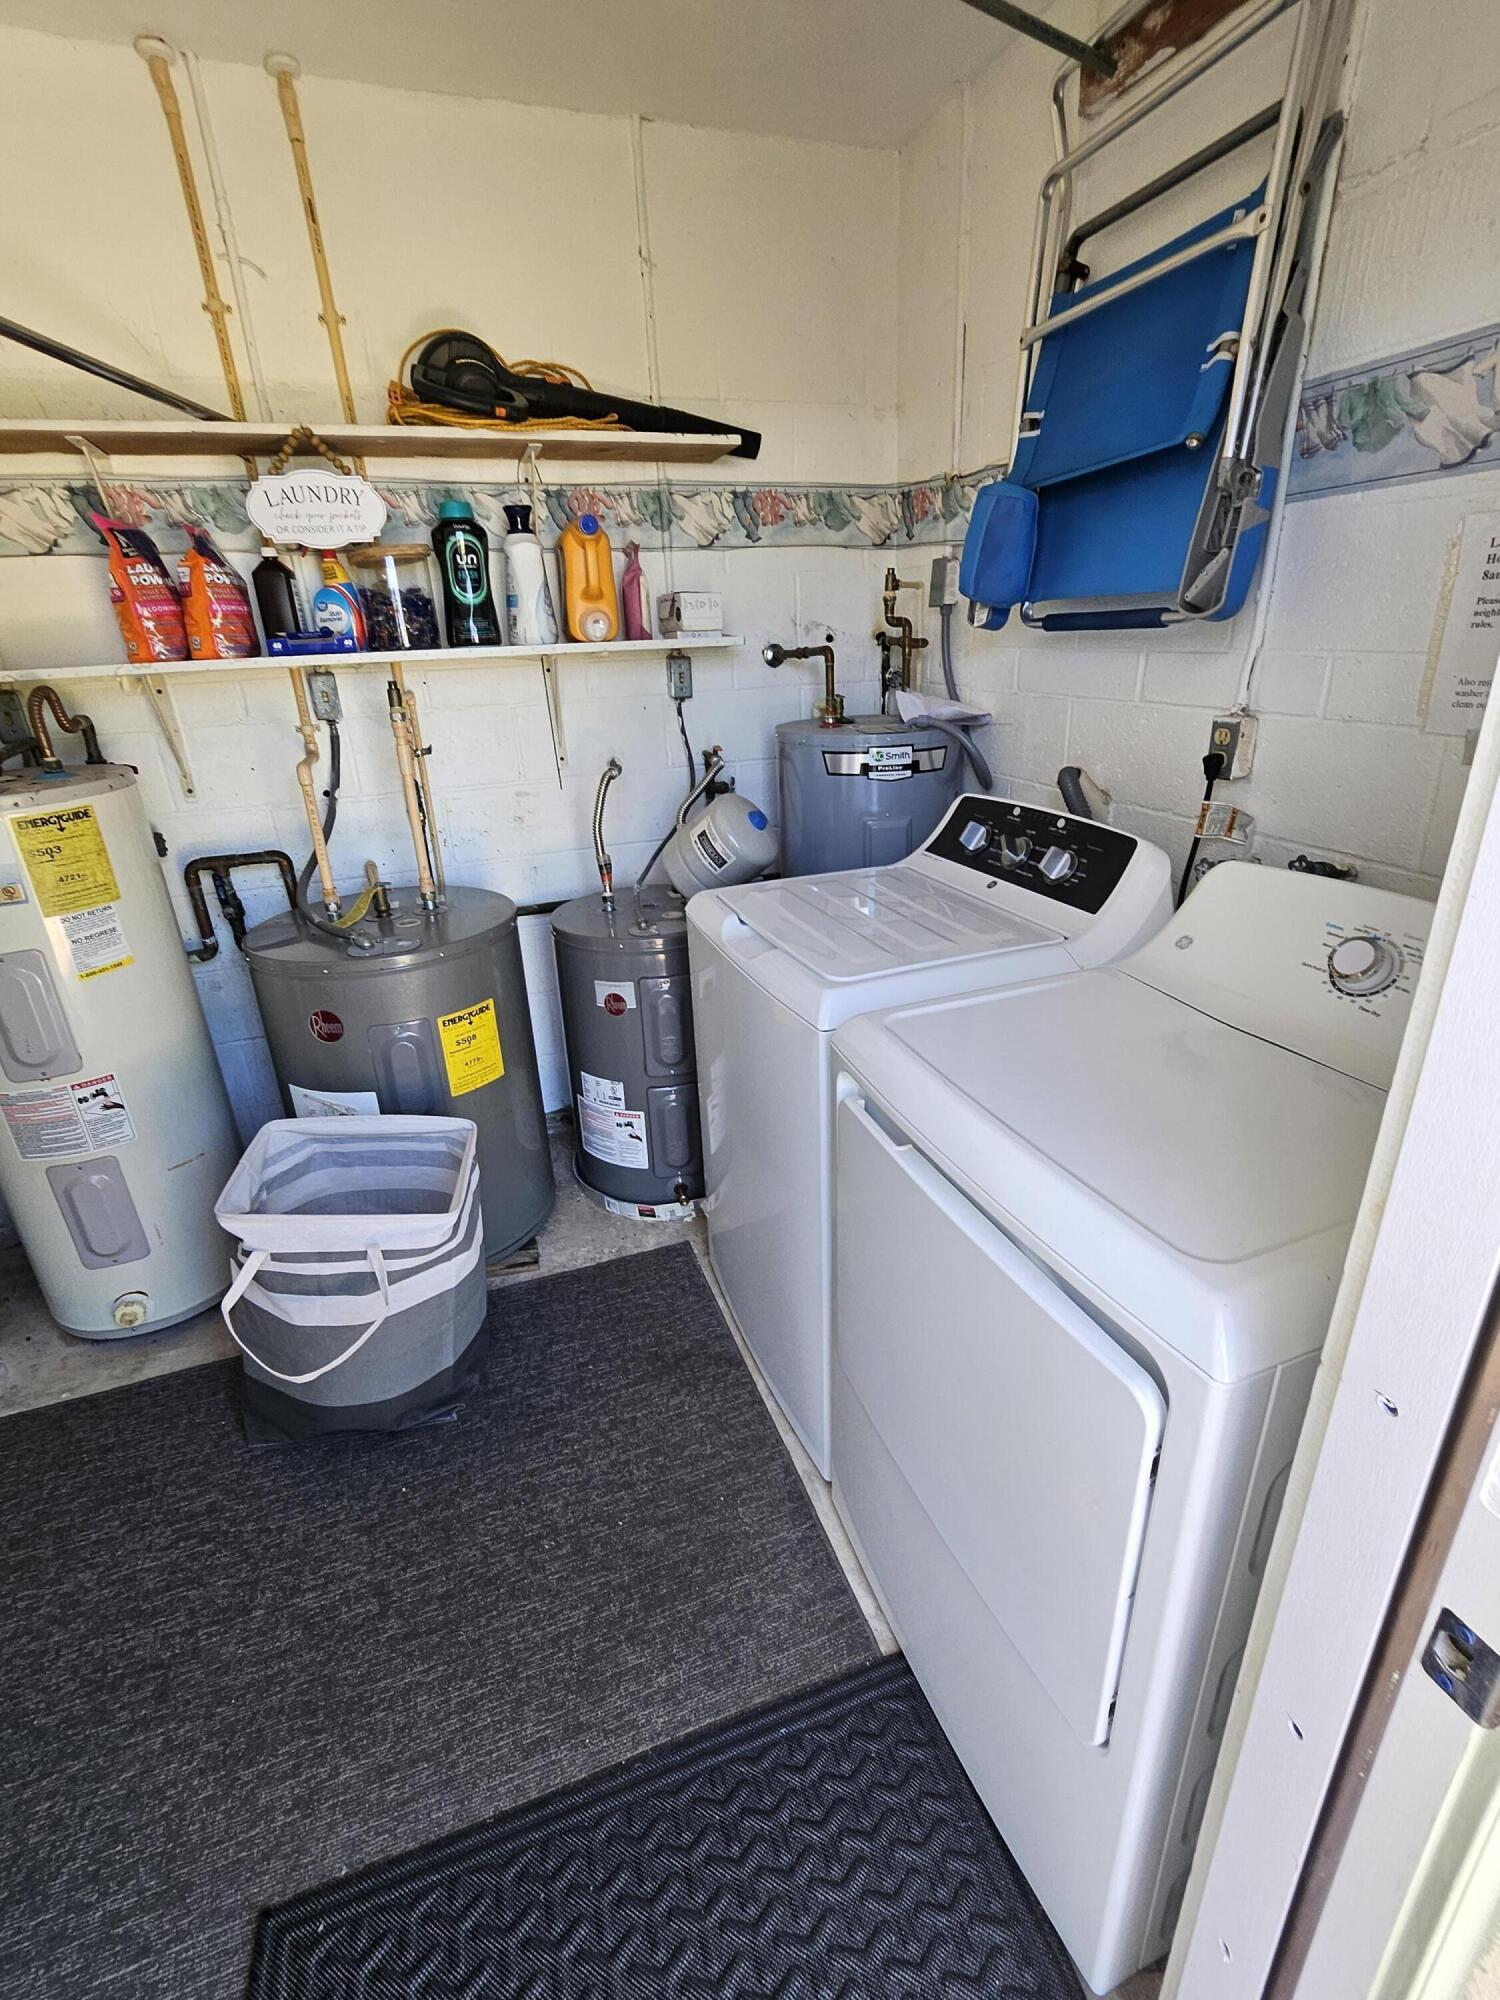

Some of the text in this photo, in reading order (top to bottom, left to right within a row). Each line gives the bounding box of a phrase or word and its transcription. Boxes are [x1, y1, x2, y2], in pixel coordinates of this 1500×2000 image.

[263, 485, 363, 508] LAUNDRY
[273, 507, 363, 524] check your pockets
[275, 525, 291, 534] OR
[291, 523, 335, 534] CONSIDER
[336, 525, 345, 533] IT
[346, 525, 354, 533] A
[1457, 677, 1477, 687] Also
[1454, 689, 1484, 698] washer
[1451, 700, 1474, 709] clean
[885, 751, 911, 760] Smith
[17, 808, 91, 831] ENERGYGUIDE
[71, 911, 85, 921] NOT
[87, 905, 112, 917] RETURN
[71, 926, 117, 945] NO REGRESE
[442, 1003, 491, 1027] ENERGYGUIDE
[311, 1010, 342, 1038] Rheem
[81, 1076, 113, 1088] DANGER
